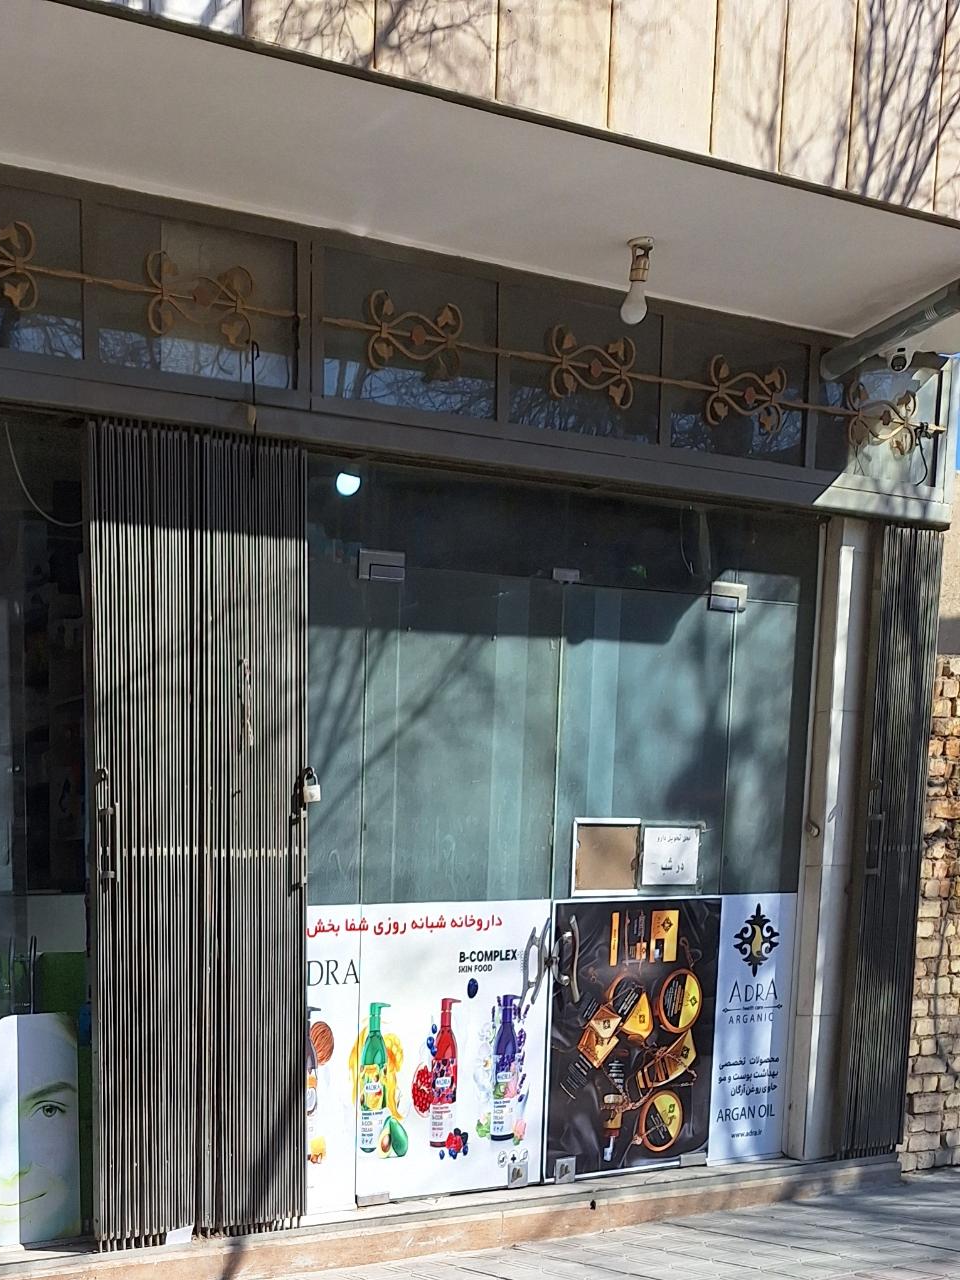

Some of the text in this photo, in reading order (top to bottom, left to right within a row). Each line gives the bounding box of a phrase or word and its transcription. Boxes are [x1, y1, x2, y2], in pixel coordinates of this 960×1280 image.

[660, 857, 685, 876] در شب
[306, 914, 503, 938] داروخانه شبانه روزی شفا بخش
[459, 948, 518, 963] B-COMPLEX
[306, 959, 360, 987] DRA
[458, 964, 493, 974] SKIN FOOD
[729, 978, 778, 1003] ADRA
[728, 1012, 775, 1024] ARGANIC
[719, 1056, 780, 1070] محصولات تخصصی
[718, 1076, 727, 1084] مو
[732, 1072, 753, 1082] پوست
[753, 1069, 779, 1079] بهداشت
[761, 1083, 778, 1093] حاوی
[716, 1104, 776, 1122] ARGAN OIL
